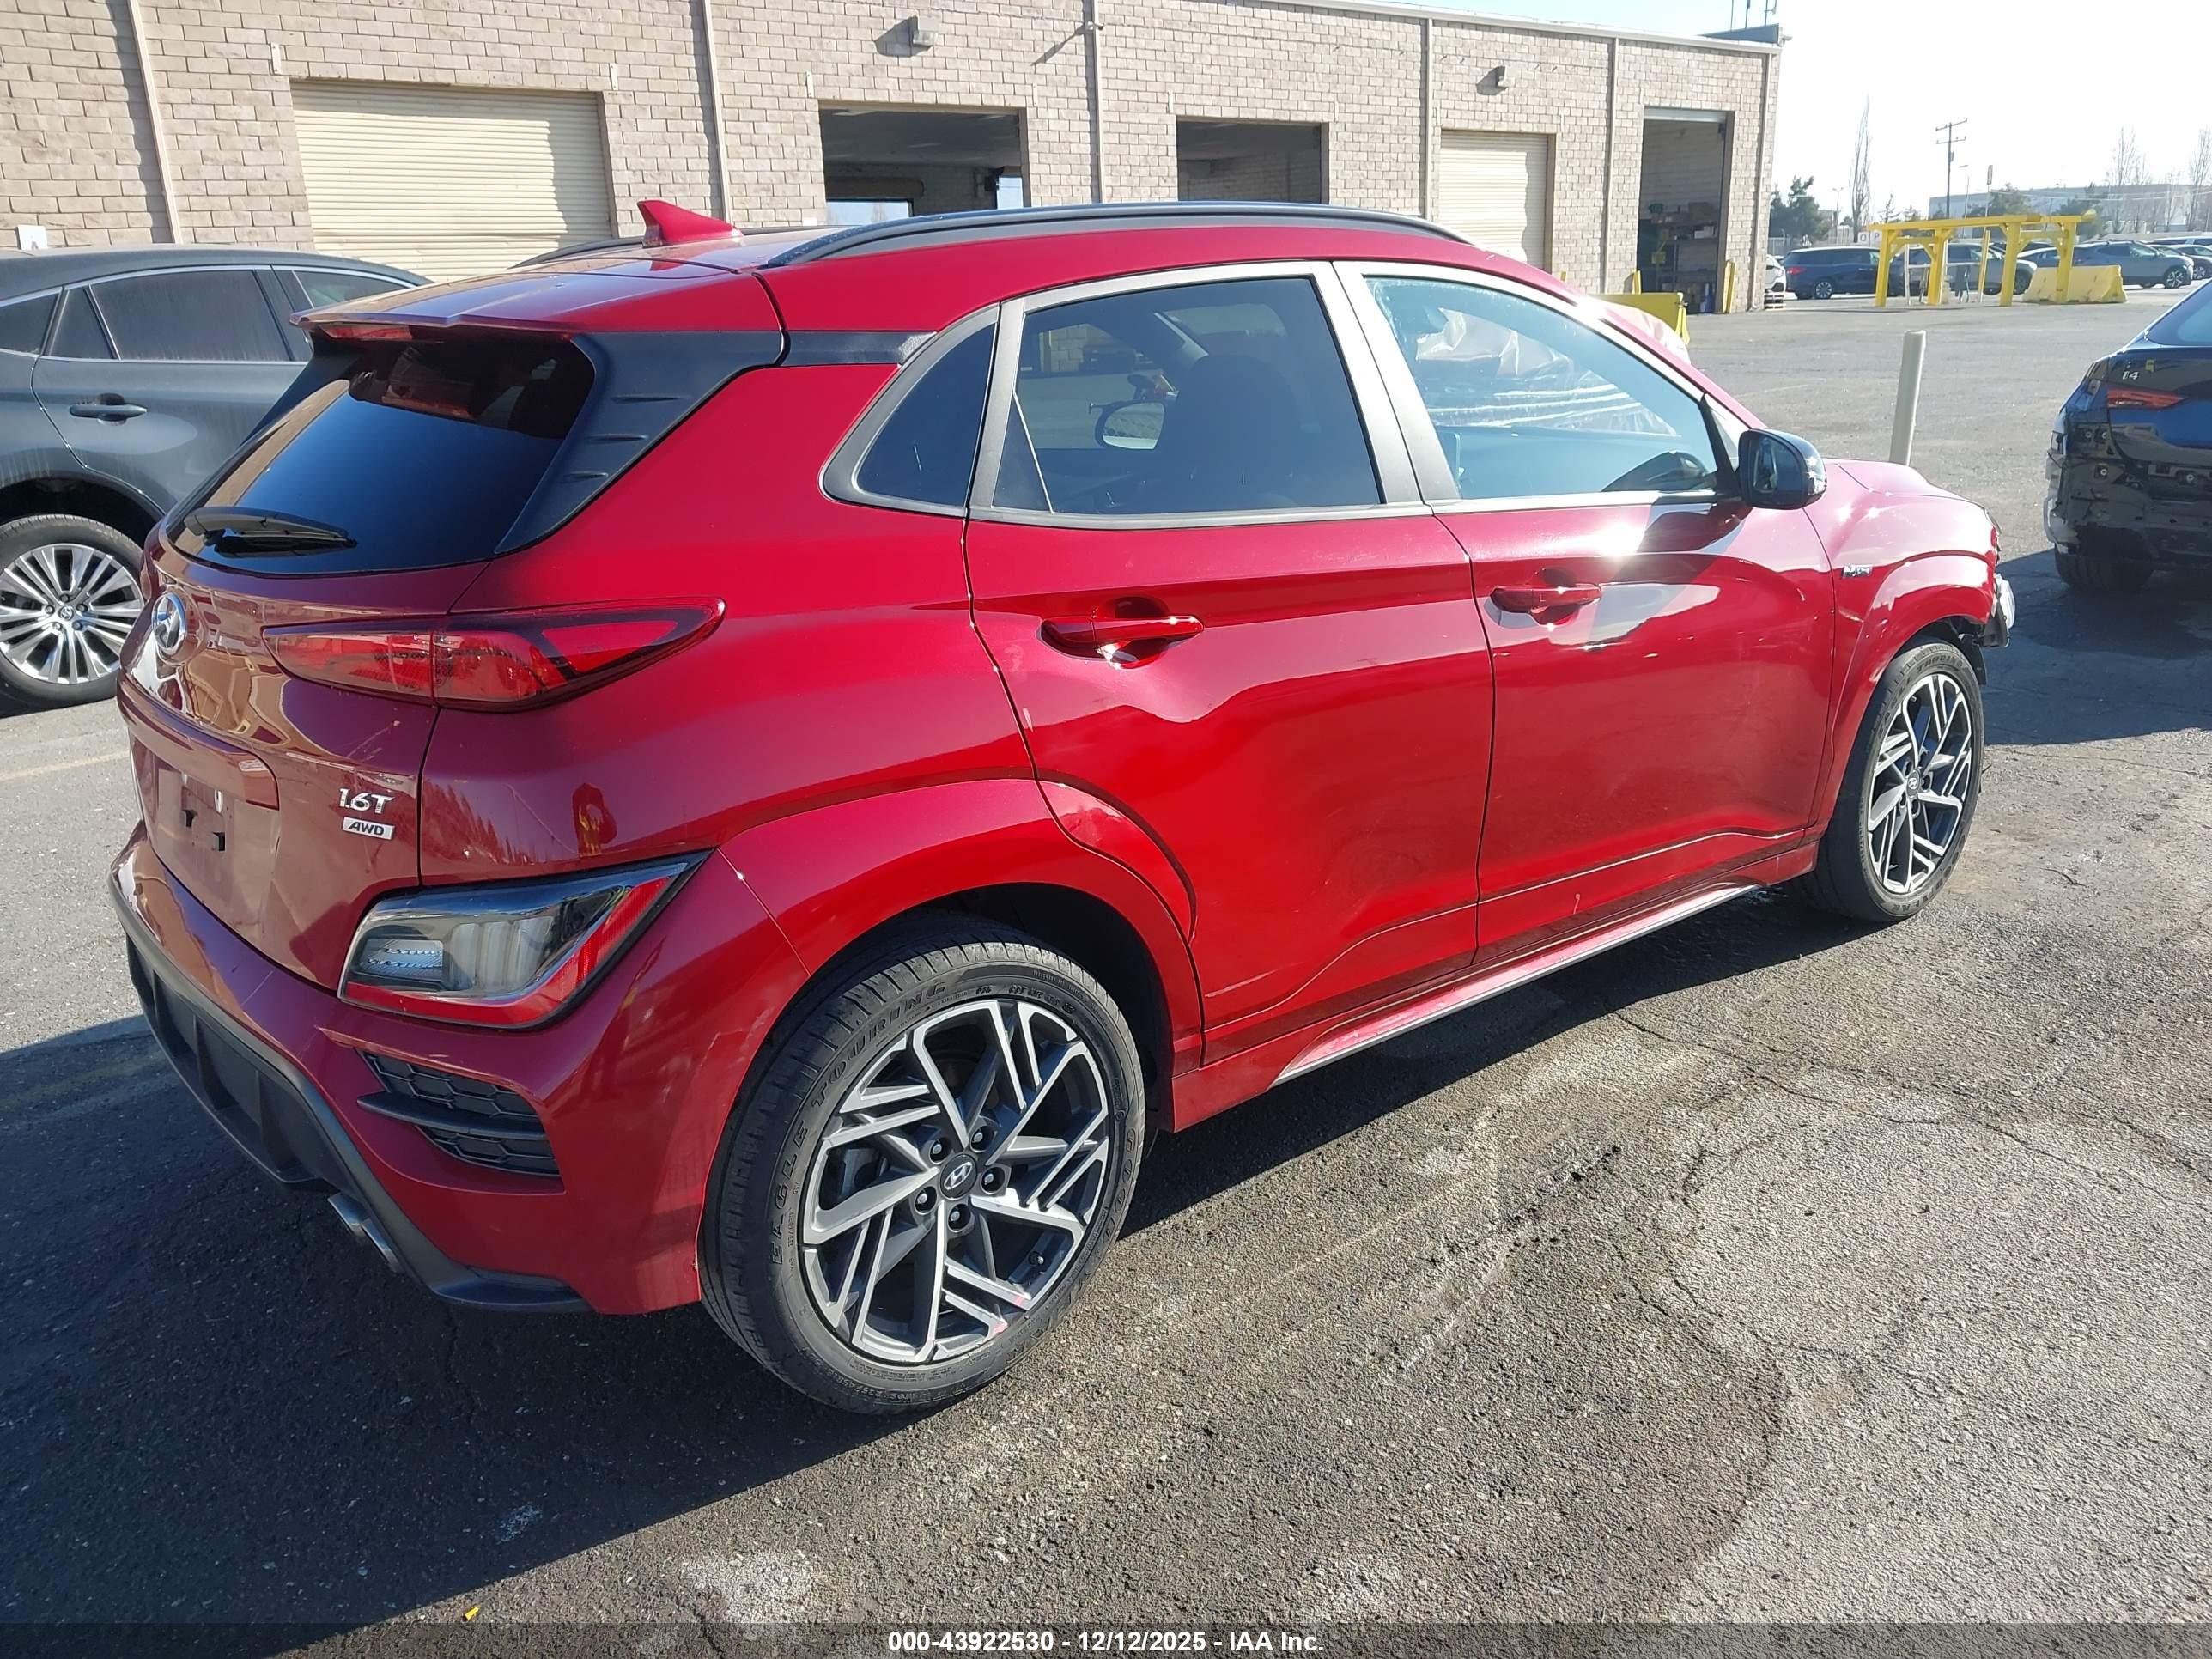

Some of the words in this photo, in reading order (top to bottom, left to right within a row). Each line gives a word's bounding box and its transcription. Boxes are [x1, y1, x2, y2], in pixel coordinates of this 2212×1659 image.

[339, 788, 395, 814] 1.6T
[349, 821, 385, 836] AWD
[771, 1119, 809, 1265] EAGLE
[811, 981, 946, 1107] TOURING
